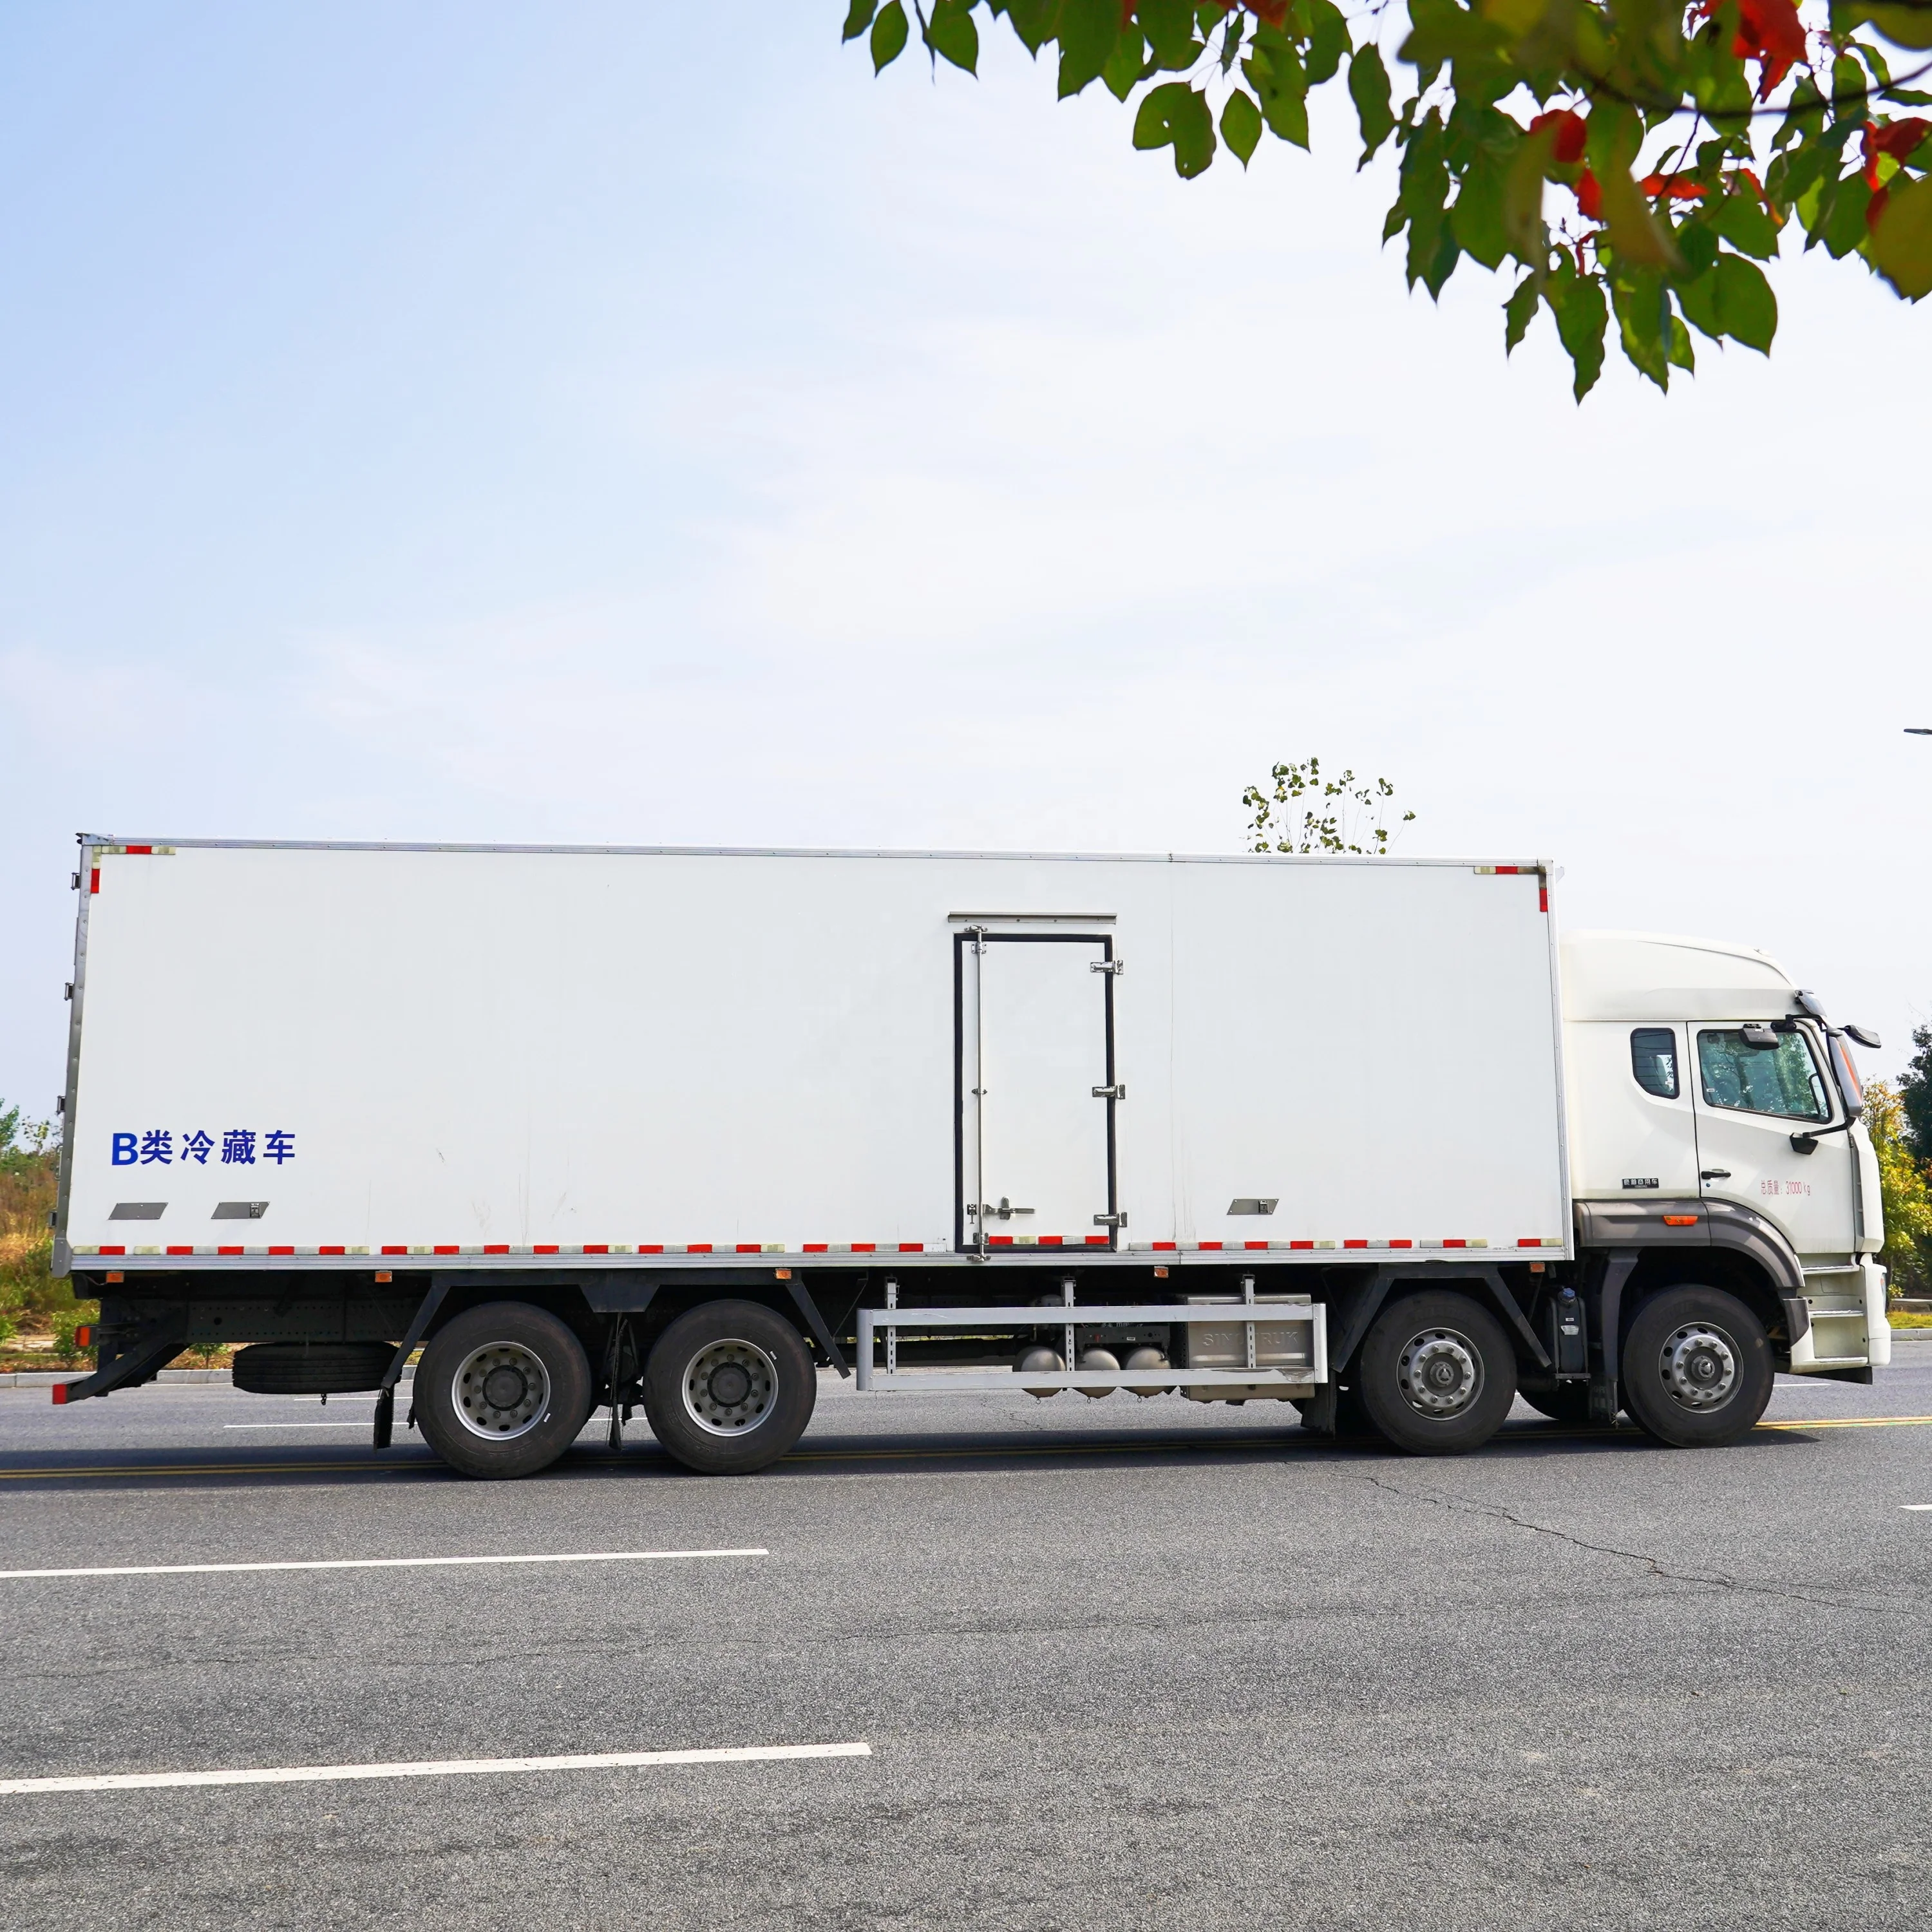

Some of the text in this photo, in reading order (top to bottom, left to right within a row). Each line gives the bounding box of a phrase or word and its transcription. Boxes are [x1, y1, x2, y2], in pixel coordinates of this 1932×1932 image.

[111, 1130, 296, 1166] B类冷藏车
[1202, 1332, 1298, 1346] SINORUK
